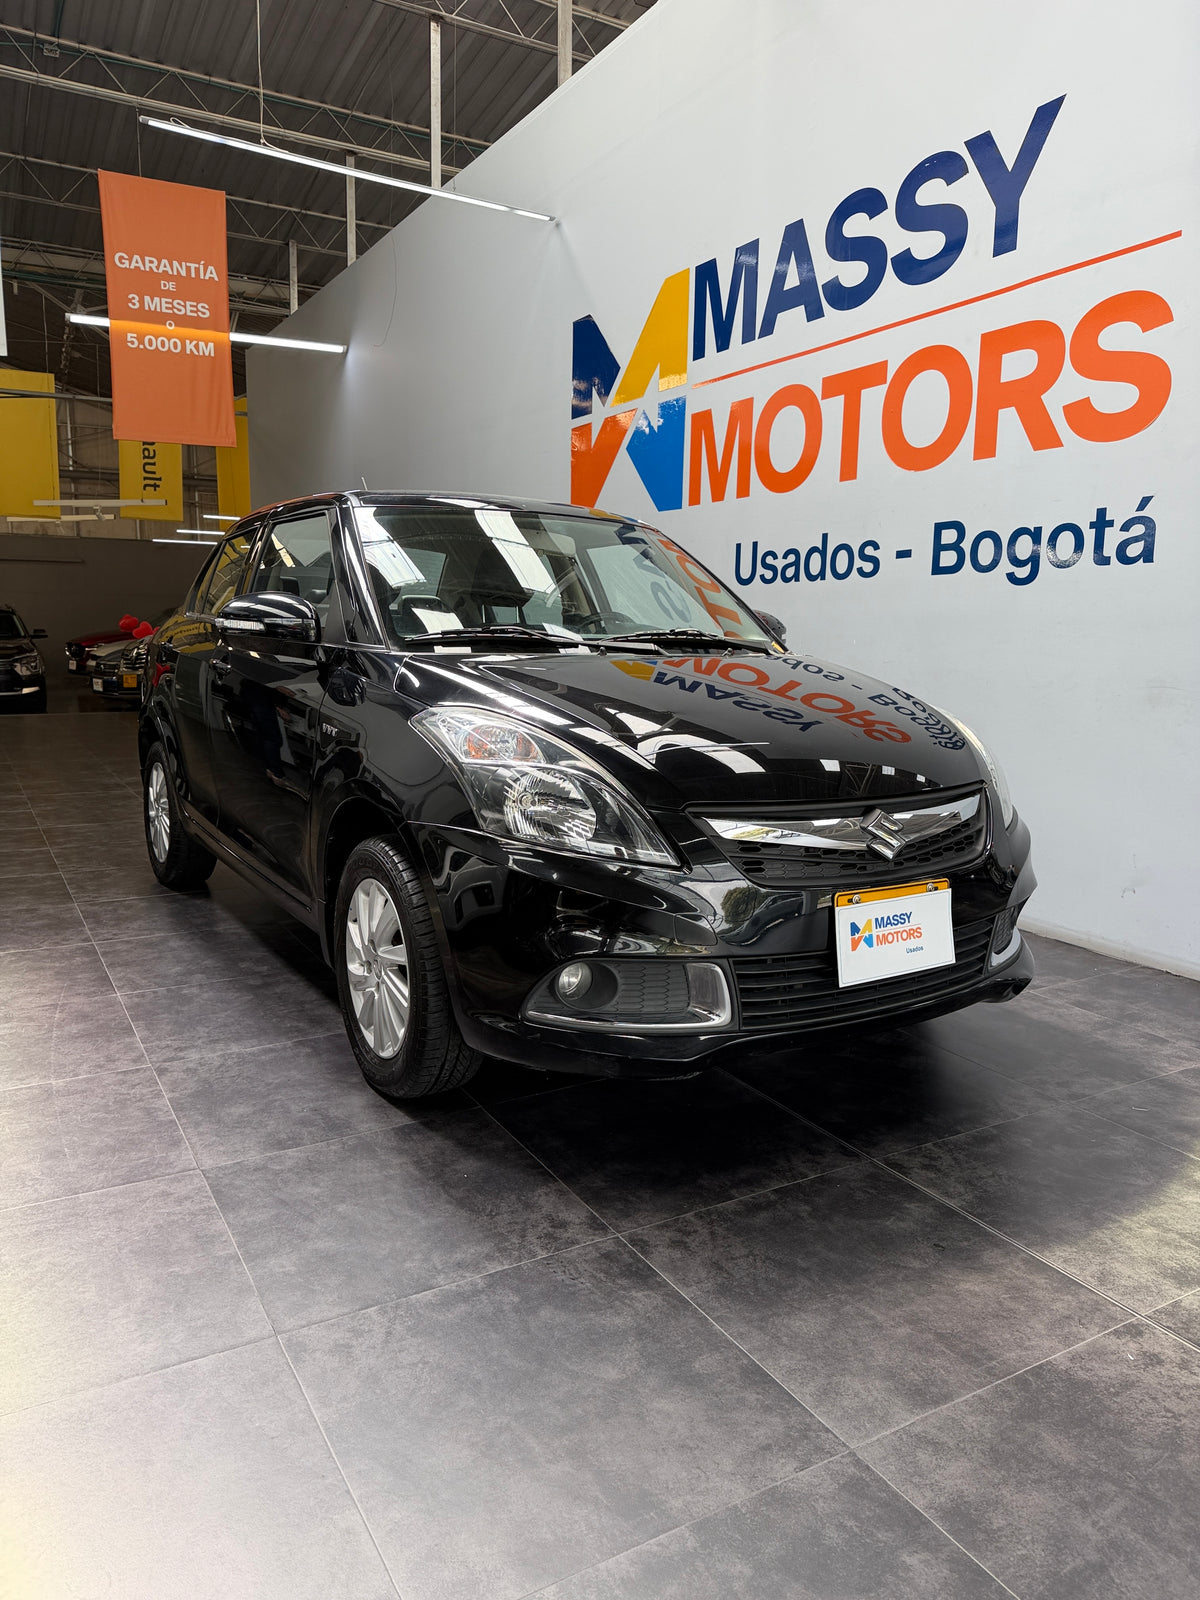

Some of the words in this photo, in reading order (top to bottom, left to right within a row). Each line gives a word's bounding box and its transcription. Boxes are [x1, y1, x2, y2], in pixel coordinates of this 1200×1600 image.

[692, 93, 1067, 362] MASSY
[114, 252, 219, 281] GARANTÍA
[160, 280, 177, 291] DE
[127, 293, 140, 309] 3
[144, 295, 210, 318] MESES
[126, 333, 182, 353] 5.000
[185, 339, 215, 357] KM
[688, 290, 1174, 507] MOTORS
[733, 532, 880, 586] Usados
[930, 495, 1157, 586] Bogotá
[875, 911, 912, 930] MASSY
[876, 927, 923, 946] MOTORS
[906, 945, 924, 954] Usados
